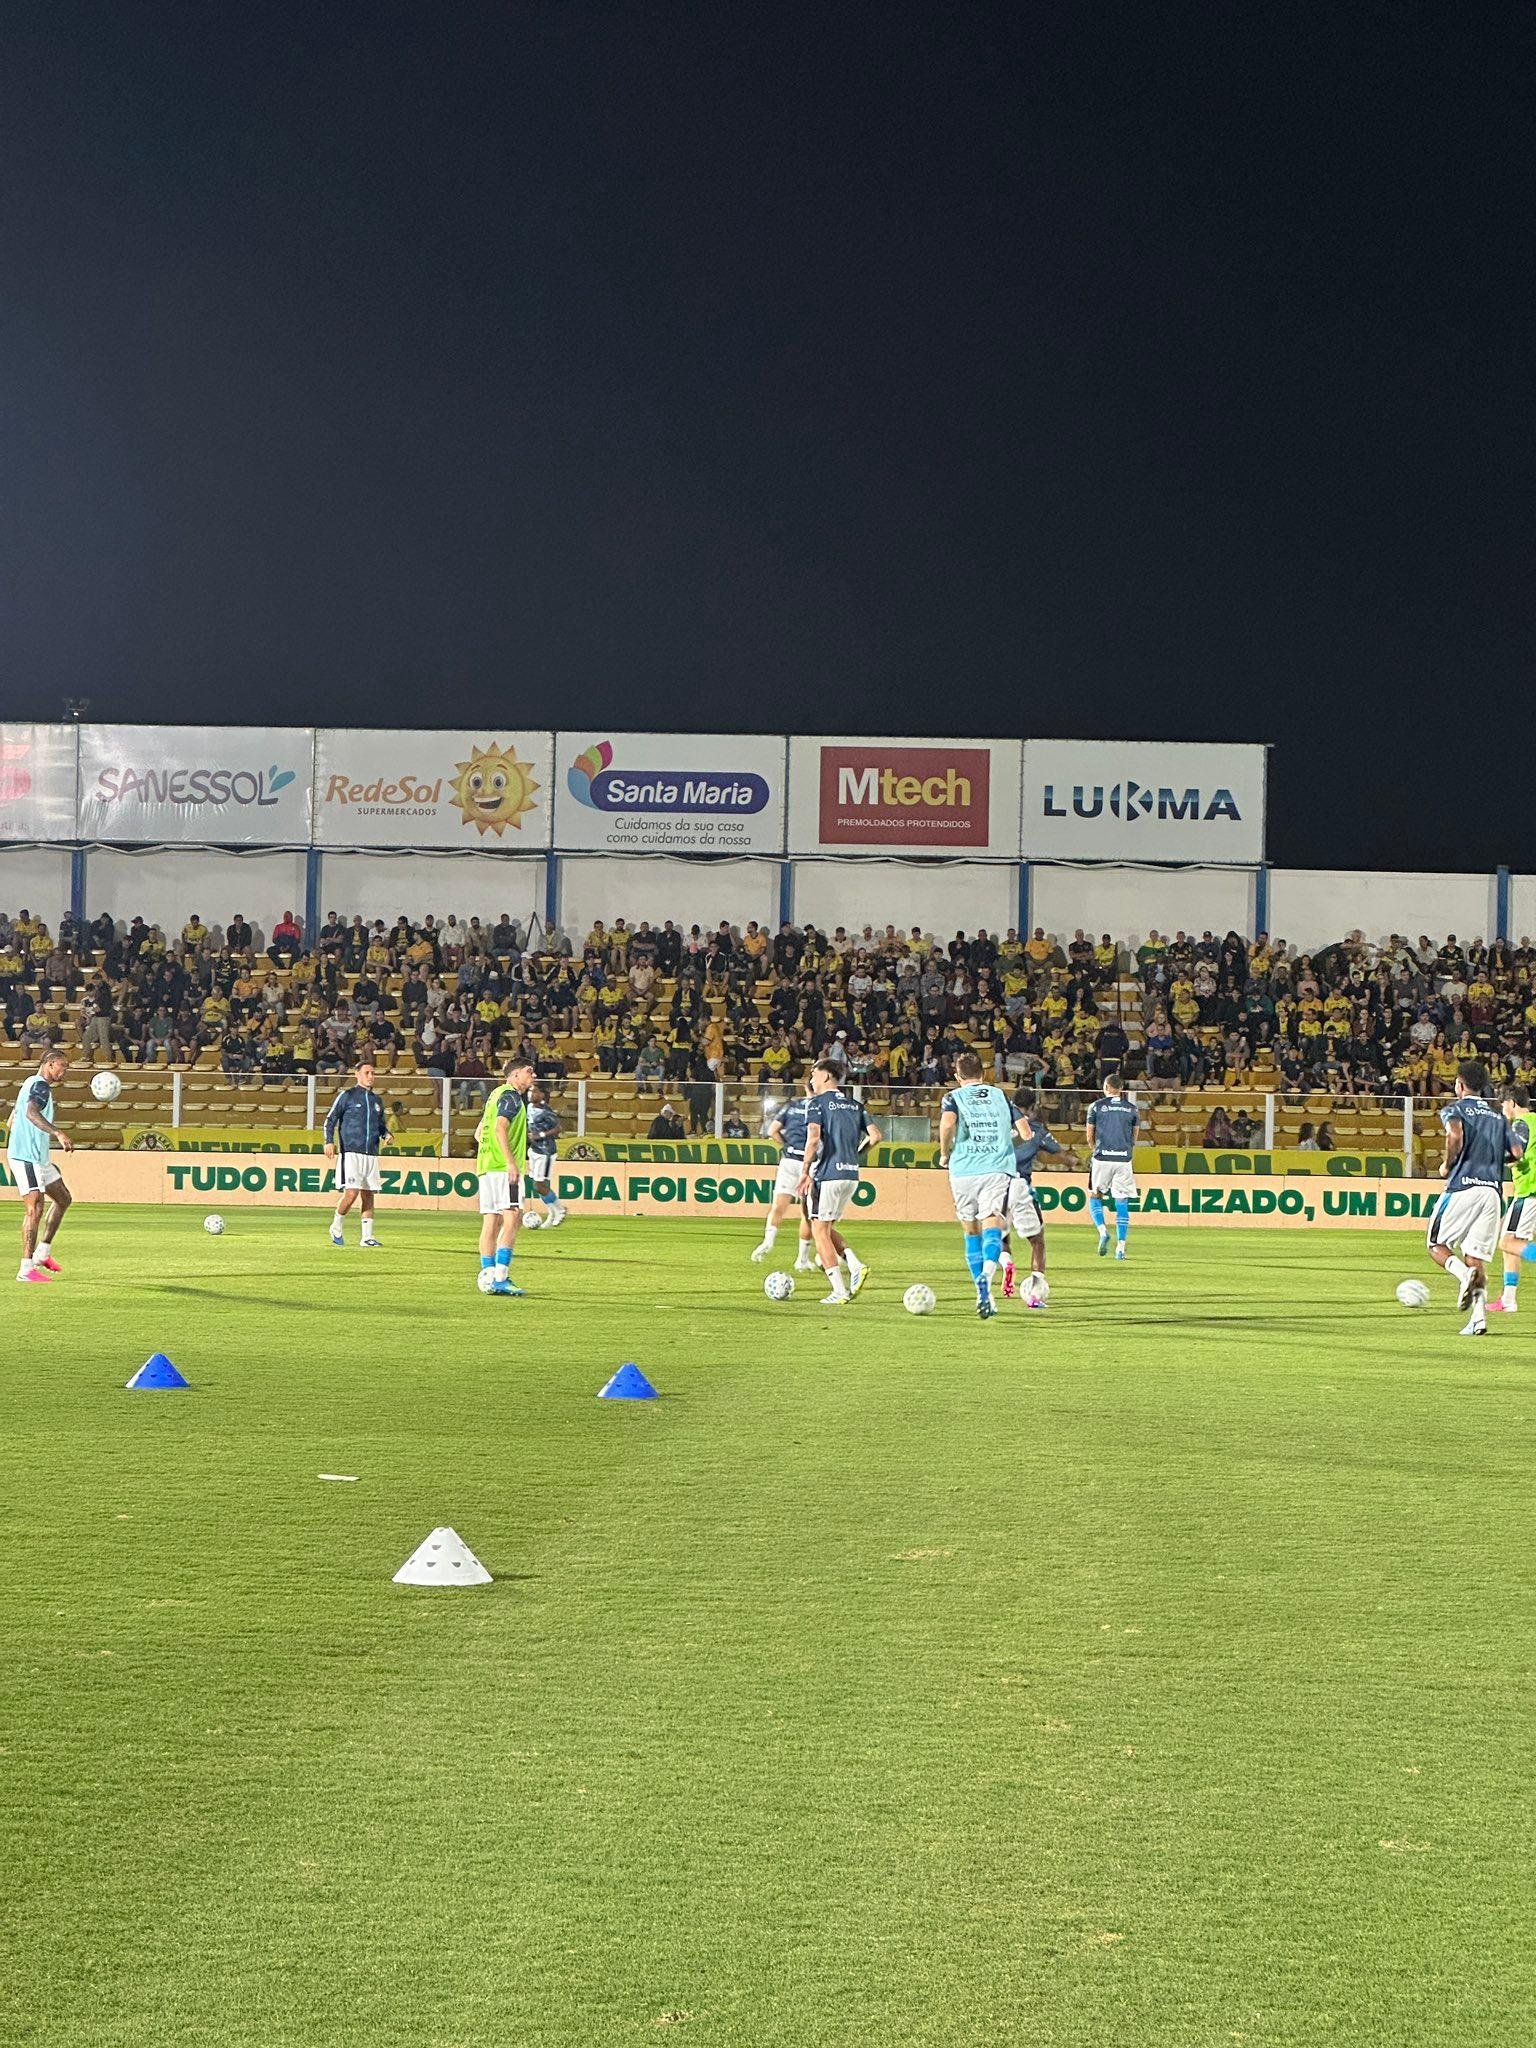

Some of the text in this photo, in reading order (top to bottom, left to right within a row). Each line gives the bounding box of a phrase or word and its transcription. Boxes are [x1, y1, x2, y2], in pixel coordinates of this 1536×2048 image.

[96, 767, 279, 805] SANESSOL
[325, 774, 443, 805] RedeSol
[606, 779, 753, 805] Santa Maria
[838, 767, 971, 806] Mtech
[1044, 781, 1242, 821] LUKMA
[357, 807, 437, 816] SUPERMERCADOS
[615, 817, 745, 832] Cuidamos da sua casa
[837, 818, 971, 829] PREMOLDADOS PROTENDIDOS
[606, 832, 751, 845] como cuidamos da nossa
[166, 1165, 268, 1192] TUDO
[274, 1167, 480, 1198] REAZADO
[558, 1175, 621, 1201] DIA
[628, 1176, 687, 1202] FOI
[694, 1177, 877, 1207] SONO
[1101, 1187, 1315, 1222] ALIZADO,
[1323, 1190, 1377, 1217] UM
